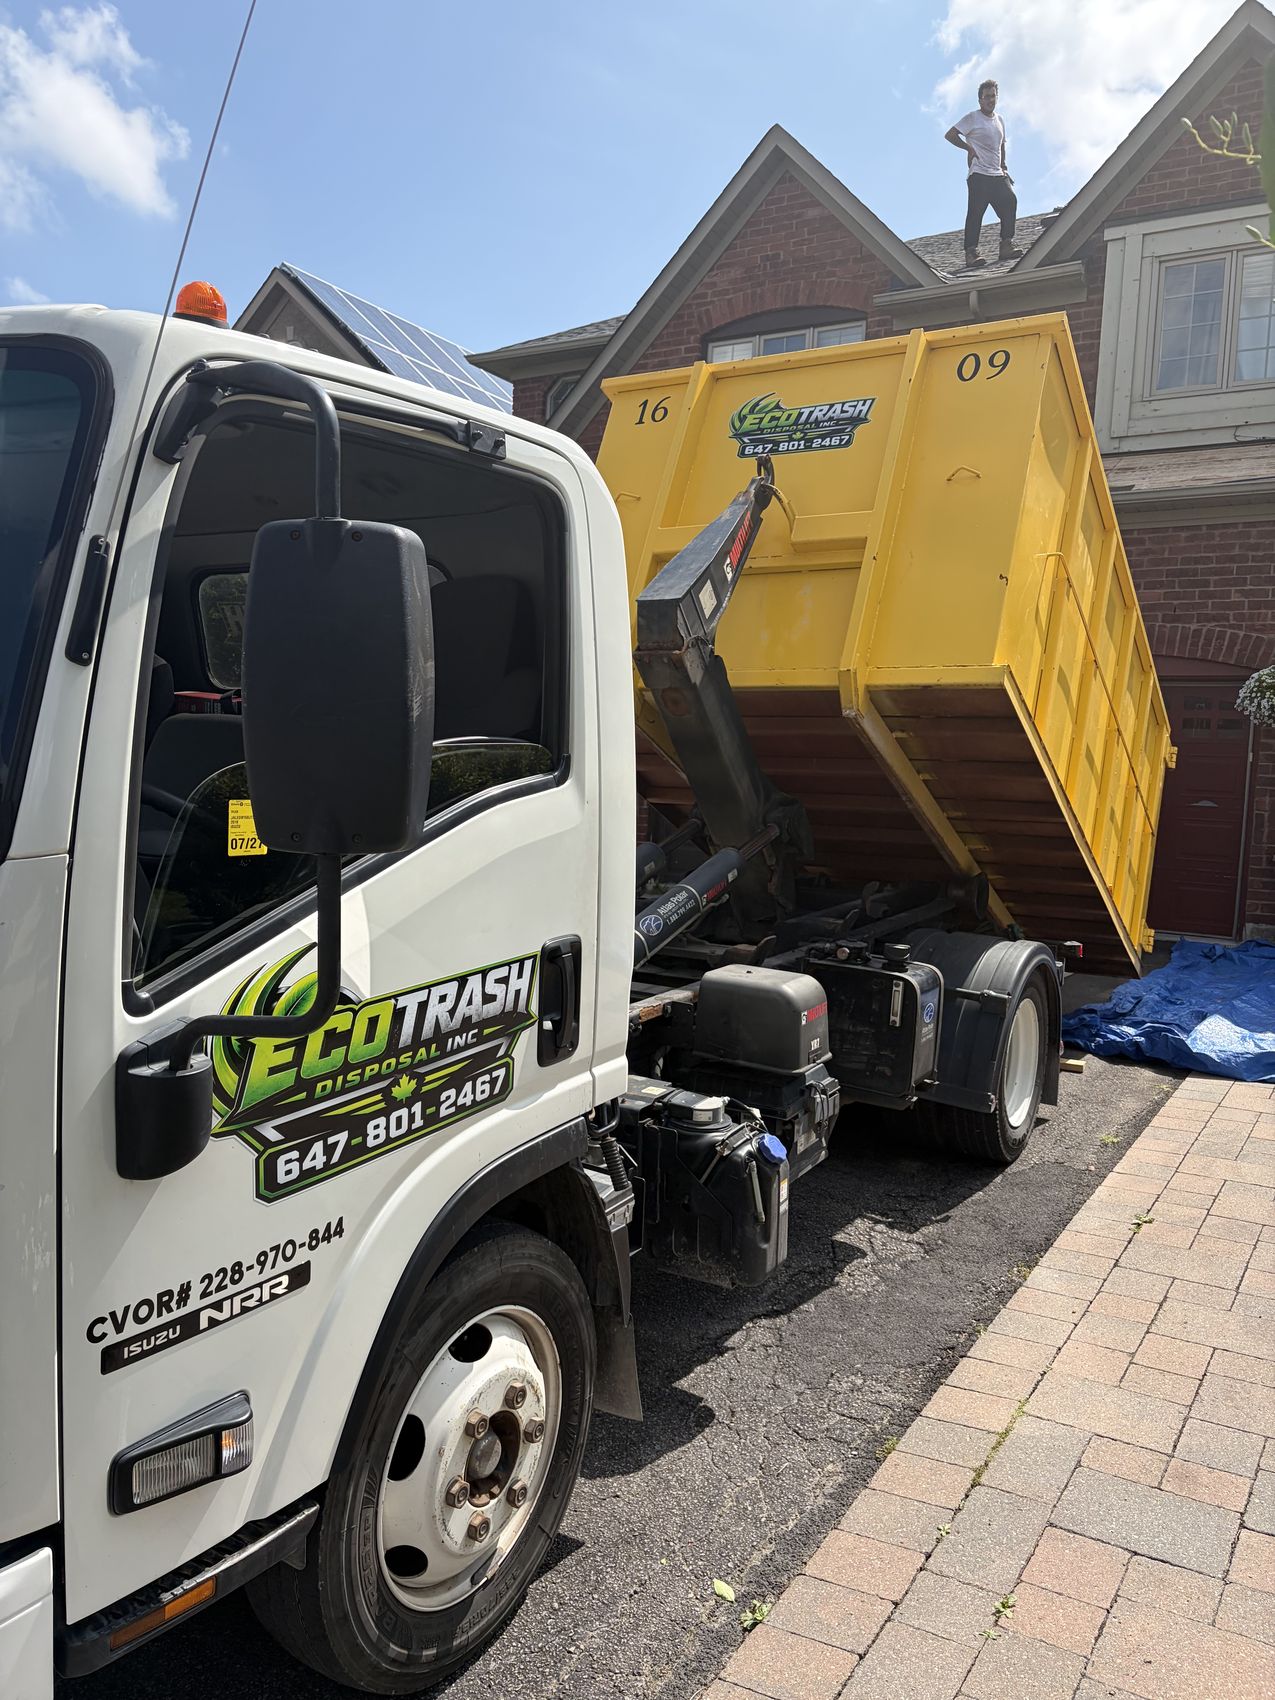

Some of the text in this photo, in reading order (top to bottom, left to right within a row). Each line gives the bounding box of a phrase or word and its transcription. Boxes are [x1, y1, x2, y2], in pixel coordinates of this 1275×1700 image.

[957, 350, 1010, 382] 09
[635, 396, 671, 425] 16
[739, 399, 873, 433] ECOTRASH
[745, 436, 850, 455] 647-801-2467
[763, 423, 816, 434] DISPOSAL
[315, 1028, 479, 1099] DISPOSAL INC
[276, 1066, 507, 1185] 647-801-2467
[86, 1216, 345, 1343] CVOR# 228-970-844
[123, 1274, 289, 1359] ISUZU NRR
